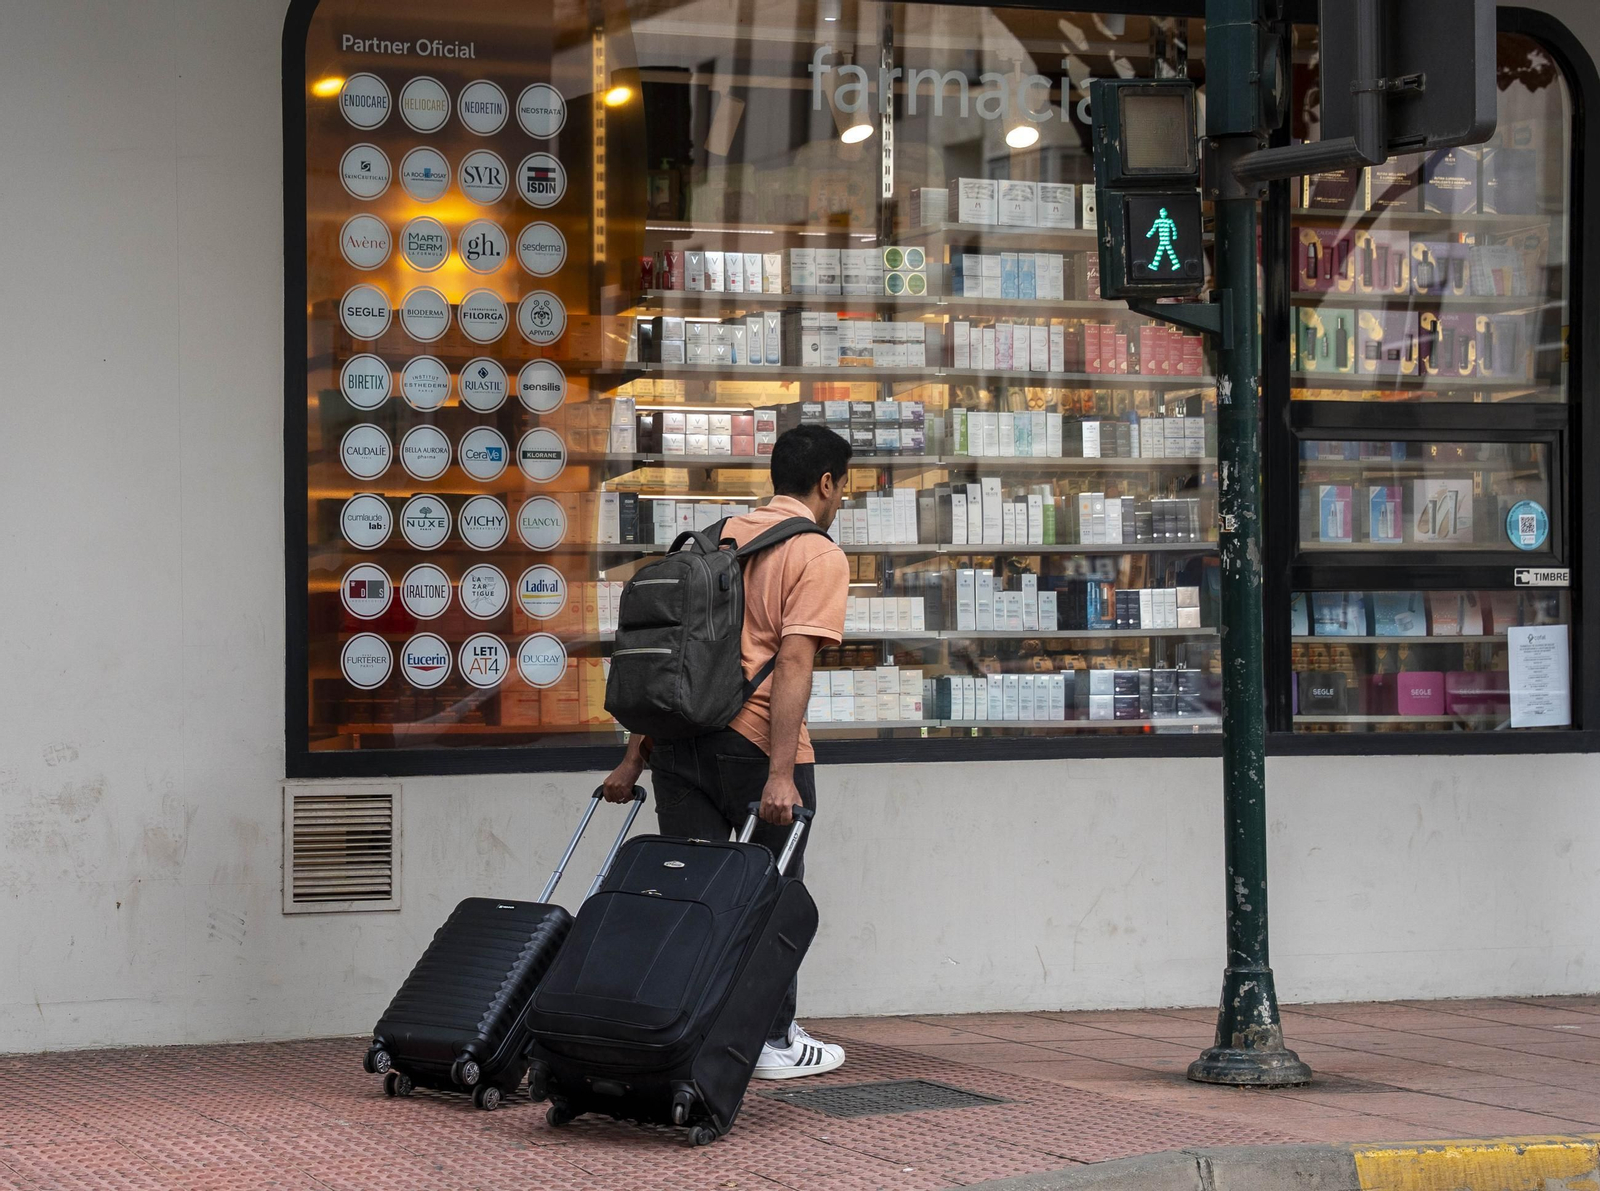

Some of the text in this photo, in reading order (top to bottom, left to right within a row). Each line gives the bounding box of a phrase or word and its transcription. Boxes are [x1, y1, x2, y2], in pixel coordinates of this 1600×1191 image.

[342, 34, 476, 58] Partner Oficial
[344, 94, 387, 109] ENDOCARE
[404, 98, 446, 112] HELIOCARE
[464, 101, 502, 115] NEORETIN
[521, 107, 562, 116] NEOSTRATA
[464, 166, 502, 185] SVR
[527, 182, 556, 194] ISDIN
[346, 235, 386, 250] Avène
[408, 232, 442, 242] MARTI
[408, 242, 442, 252] DERM
[467, 233, 500, 260] gh.
[522, 242, 561, 253] sesderma
[347, 306, 385, 318] SEGLE
[407, 308, 444, 316] BIODERMA
[463, 312, 504, 320] FILORGA
[348, 374, 384, 390] BIRETIX
[465, 380, 502, 391] RILASTIL
[522, 382, 560, 392] sensilis
[346, 445, 386, 456] CAUDALÍE
[466, 448, 500, 460] CeraVe
[347, 514, 382, 522] cumlaude
[464, 516, 504, 526] VICHY
[522, 518, 560, 527] ELANCYL
[1534, 572, 1568, 581] TIMBRE
[406, 584, 446, 598] IRALTONE
[526, 580, 558, 593] Ladival
[474, 646, 497, 656] LETI
[407, 653, 446, 665] Eucerin
[523, 654, 561, 663] DUCRAY
[469, 658, 500, 675] AT4
